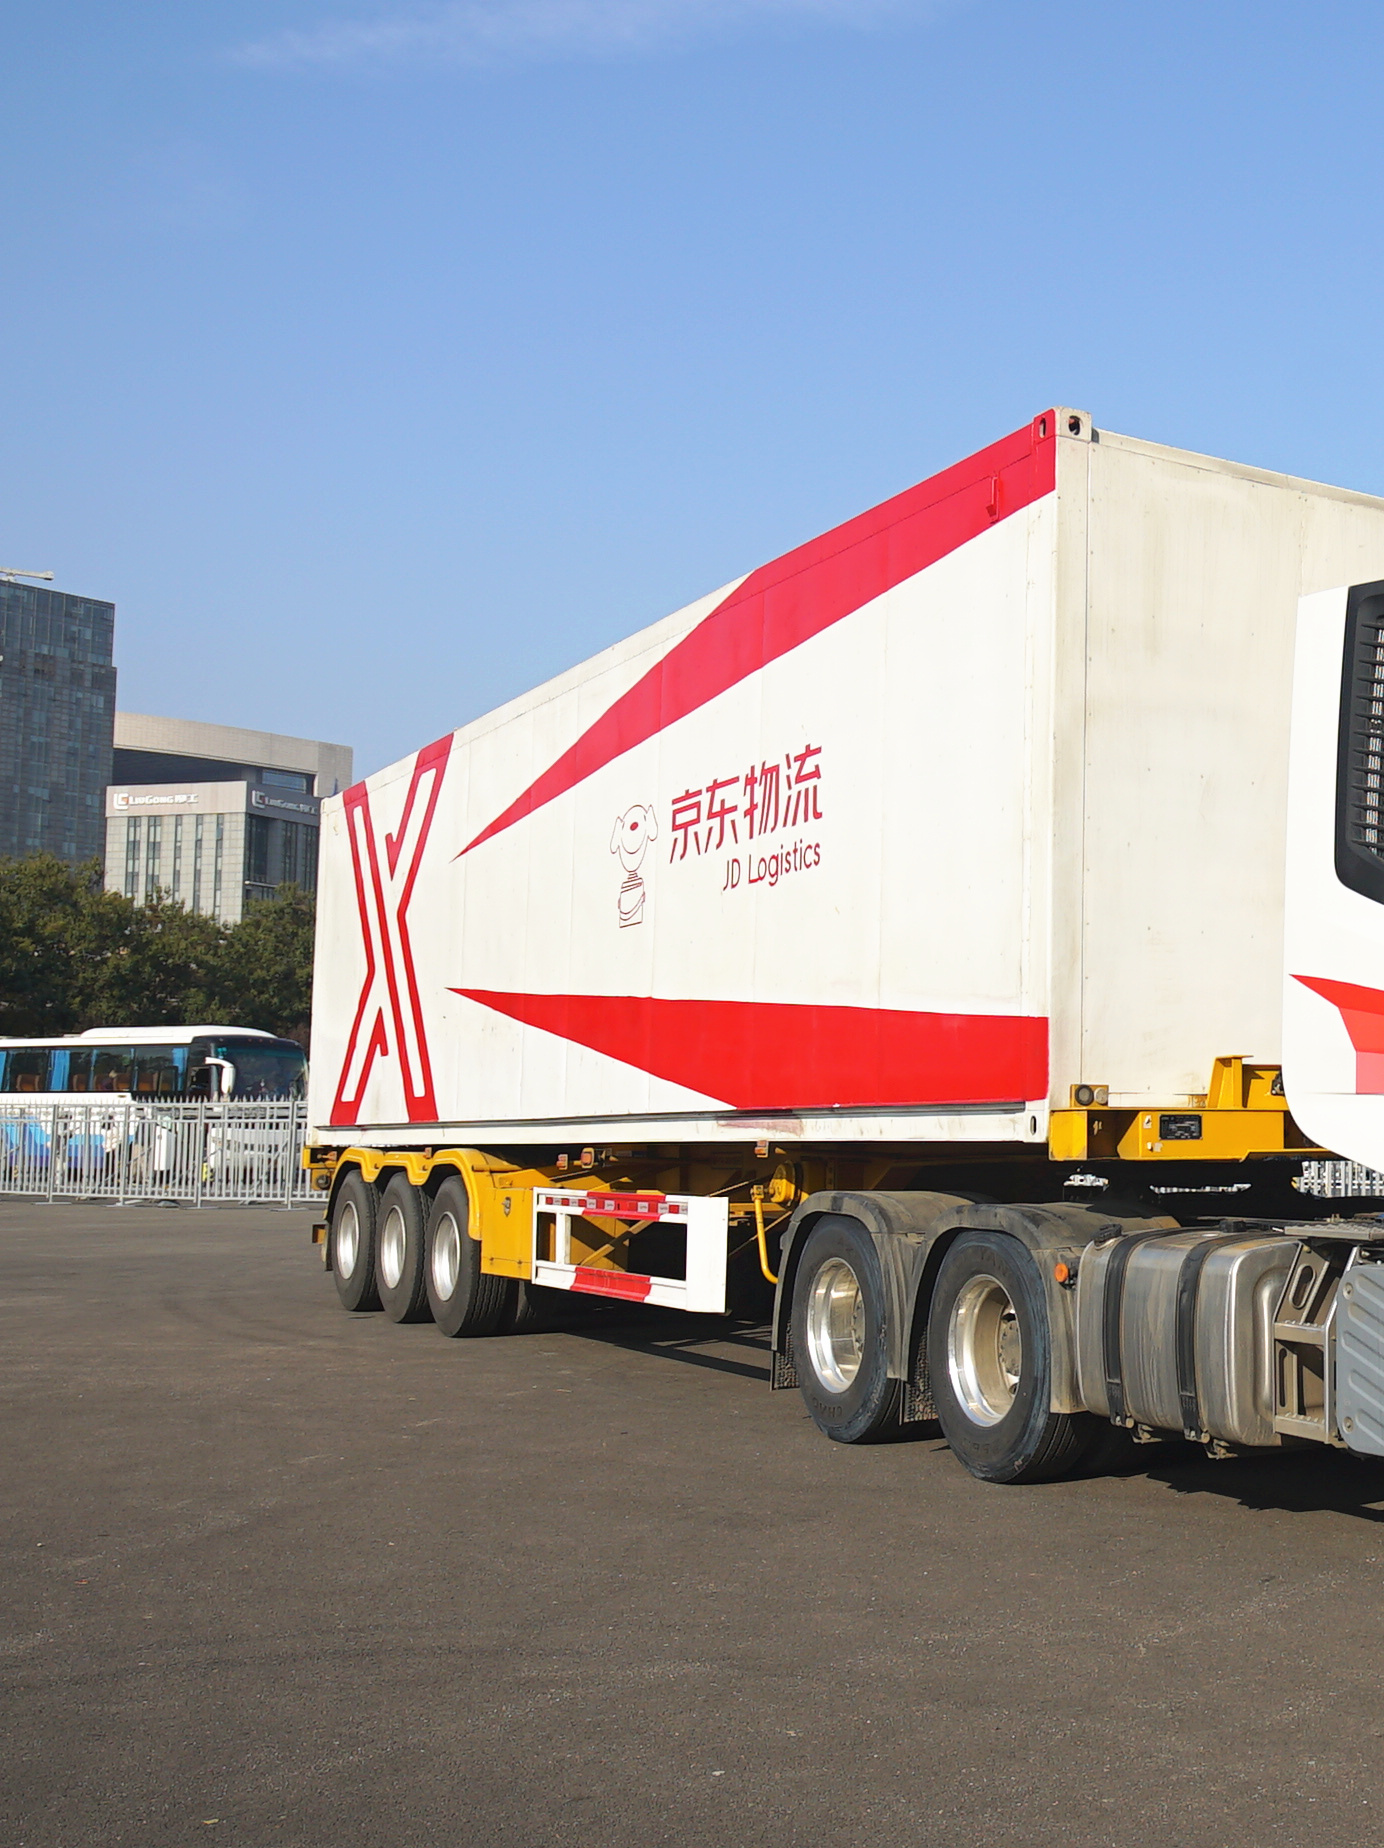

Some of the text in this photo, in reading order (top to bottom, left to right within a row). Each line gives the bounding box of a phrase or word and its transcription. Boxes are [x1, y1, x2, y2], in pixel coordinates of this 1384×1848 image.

[669, 743, 823, 864] 京东物流
[723, 838, 821, 891] JD Logistics
